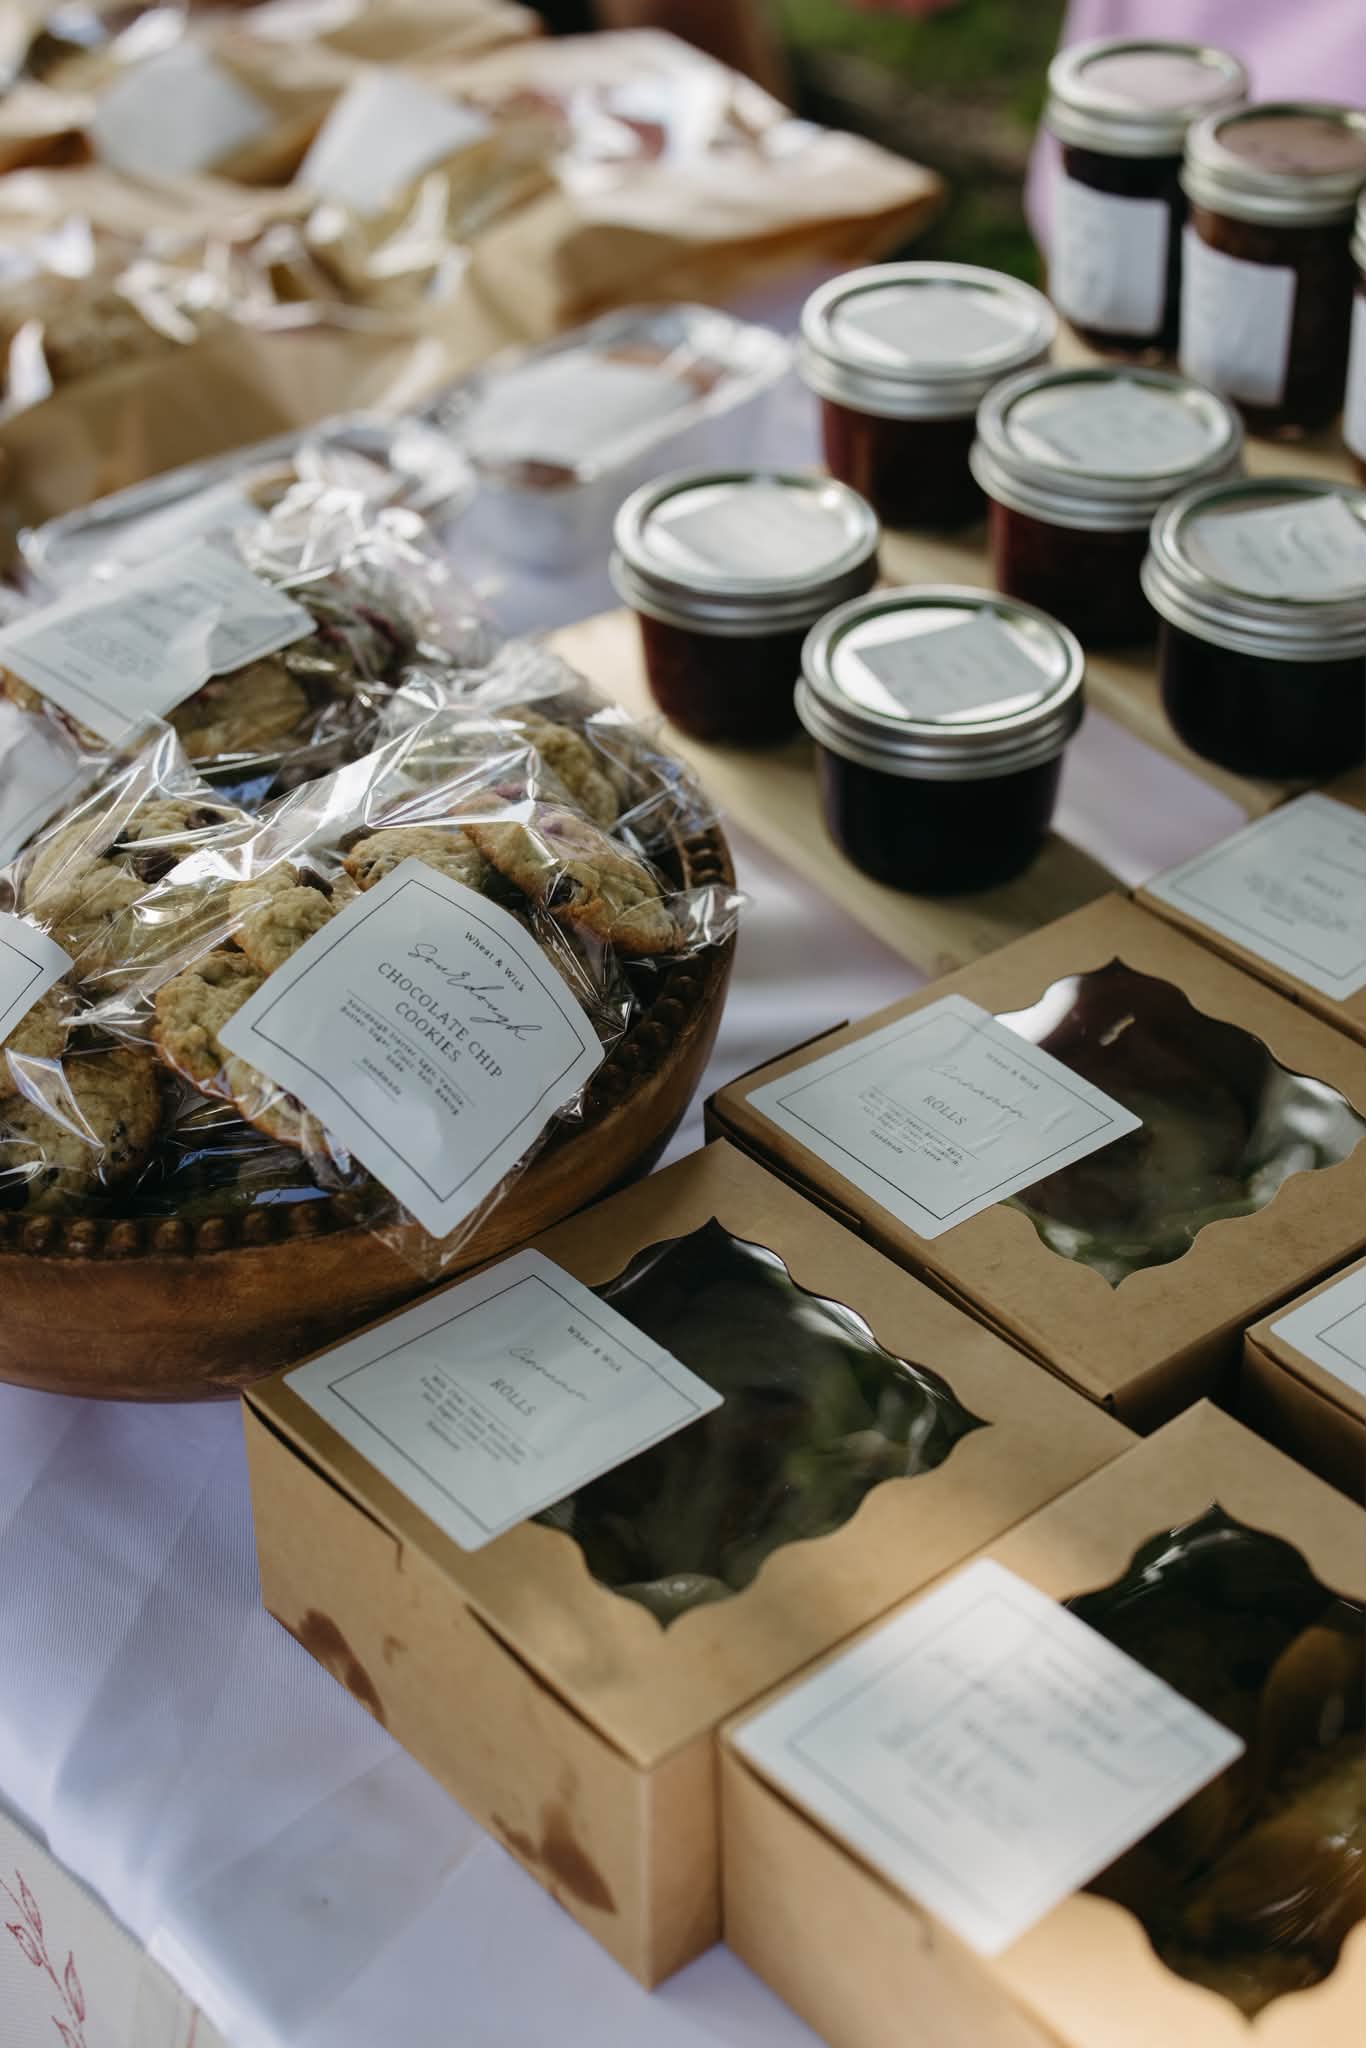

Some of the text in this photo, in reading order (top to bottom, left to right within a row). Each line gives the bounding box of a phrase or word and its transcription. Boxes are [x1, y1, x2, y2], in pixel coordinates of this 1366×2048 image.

[407, 943, 543, 1041] Sourdough
[465, 931, 526, 993] Wheat & Wick
[377, 961, 503, 1077] CHOCOLATE CHIP
[395, 1001, 462, 1062] COOKIES
[922, 1094, 968, 1127] ROLLS
[489, 1376, 537, 1417] ROLLS
